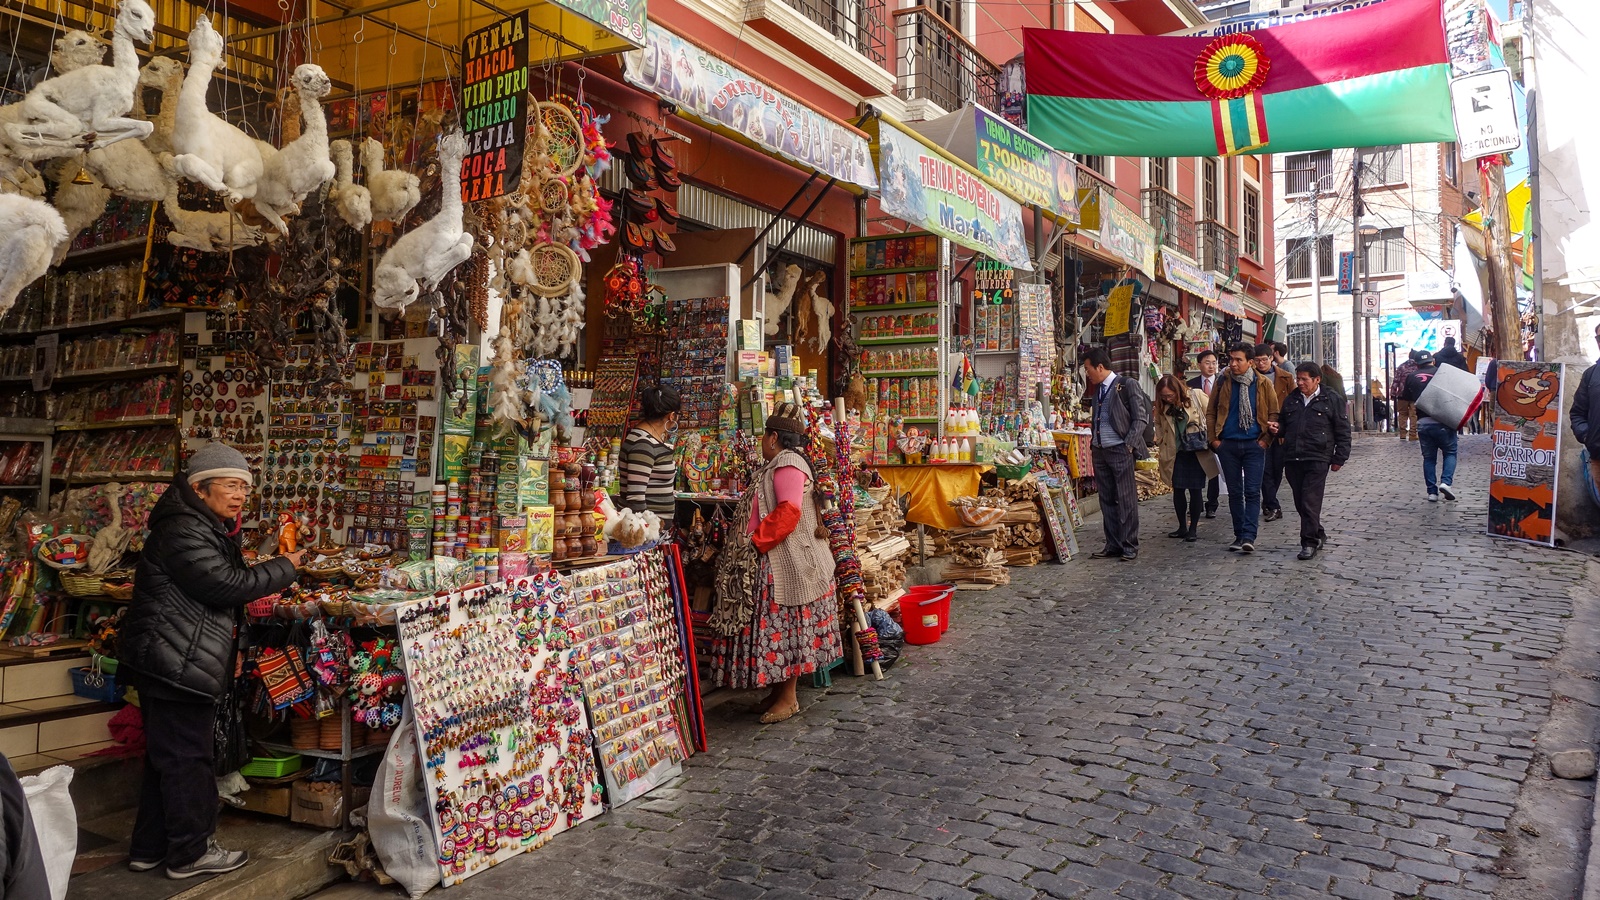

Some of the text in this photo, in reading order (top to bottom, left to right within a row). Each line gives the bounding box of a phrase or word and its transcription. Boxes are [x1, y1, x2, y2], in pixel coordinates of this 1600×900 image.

[467, 16, 525, 59] VENTA
[632, 22, 643, 39] 3
[465, 46, 516, 85] HALCOL
[698, 55, 733, 81] CASA
[463, 66, 528, 109] VINO PURO
[466, 96, 517, 132] SIGARRO
[1480, 124, 1493, 135] NO
[464, 122, 515, 155] LEJIA
[983, 116, 1051, 168] TIENDA ESOTERICA
[461, 147, 507, 178] COCA
[980, 138, 1053, 189] 7 PODERES
[461, 173, 504, 203] LEÑA
[919, 154, 1002, 227] TIENDA ESOTERICA
[987, 162, 1052, 208] LOURDES
[1057, 159, 1075, 202] 6
[975, 279, 1011, 289] LOURDES
[992, 289, 1003, 305] 6
[1494, 431, 1522, 447] THE
[1492, 460, 1526, 479] TREE
[1493, 446, 1556, 467] CARROT
[410, 541, 426, 550] Coca
